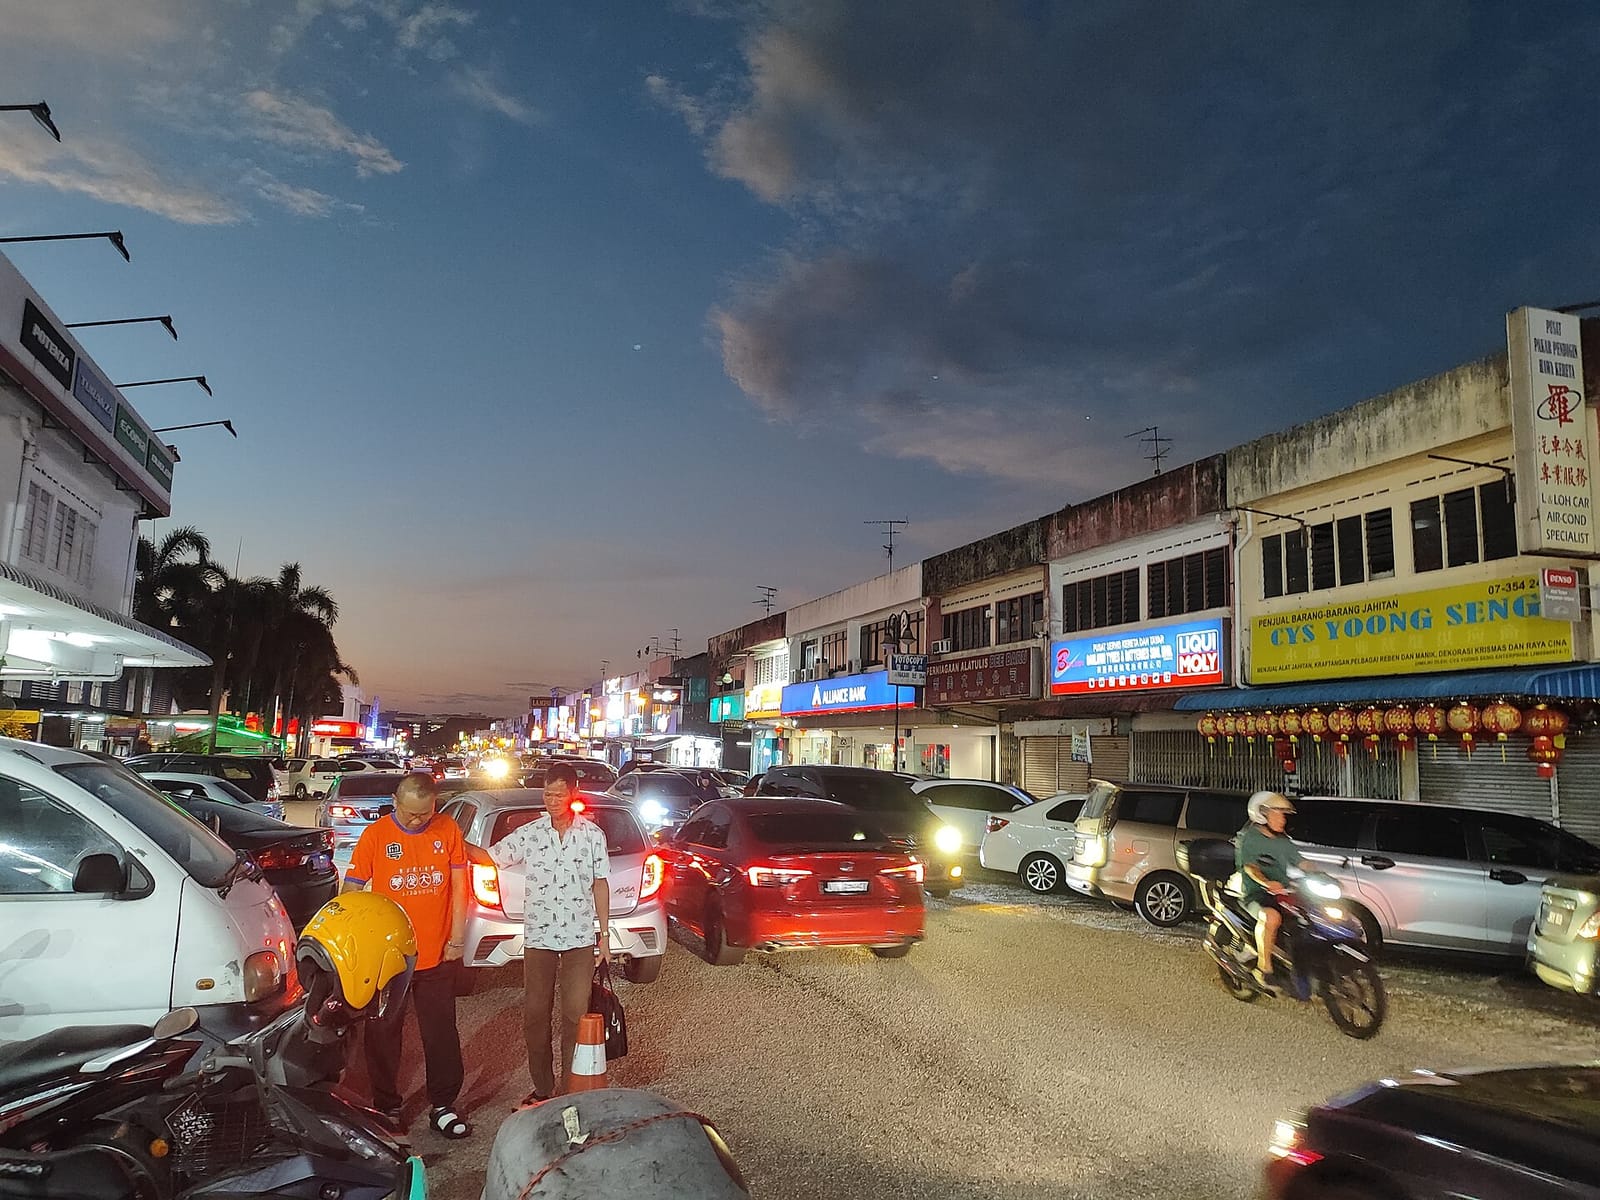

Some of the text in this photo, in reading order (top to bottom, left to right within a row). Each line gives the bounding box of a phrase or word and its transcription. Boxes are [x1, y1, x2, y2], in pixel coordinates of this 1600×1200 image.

[32, 322, 70, 372] POTENZA
[1553, 494, 1571, 507] LOH
[1573, 496, 1590, 509] CAR
[1546, 528, 1589, 544] SPECIALIST
[1488, 581, 1525, 595] 07-354
[1549, 574, 1573, 585] DENSO
[1258, 599, 1399, 629] PENJUAL BARANG-BARANG JAHITAN
[1270, 623, 1315, 646] CYS
[1325, 607, 1433, 642] YOONG
[1446, 593, 1541, 627] SENG
[1179, 632, 1217, 654] LIQUI
[960, 657, 988, 672] ALATULIS
[1179, 653, 1218, 673] MOLY
[1278, 664, 1291, 672] ALAT
[1401, 653, 1414, 661] DAN
[1438, 648, 1473, 657] DEKORASI
[1474, 644, 1507, 654] KRISMAS
[1508, 643, 1524, 651] DAN
[1526, 641, 1546, 649] RAYA
[1547, 639, 1567, 648] CINA
[822, 685, 867, 705] ALLIANCE BANK
